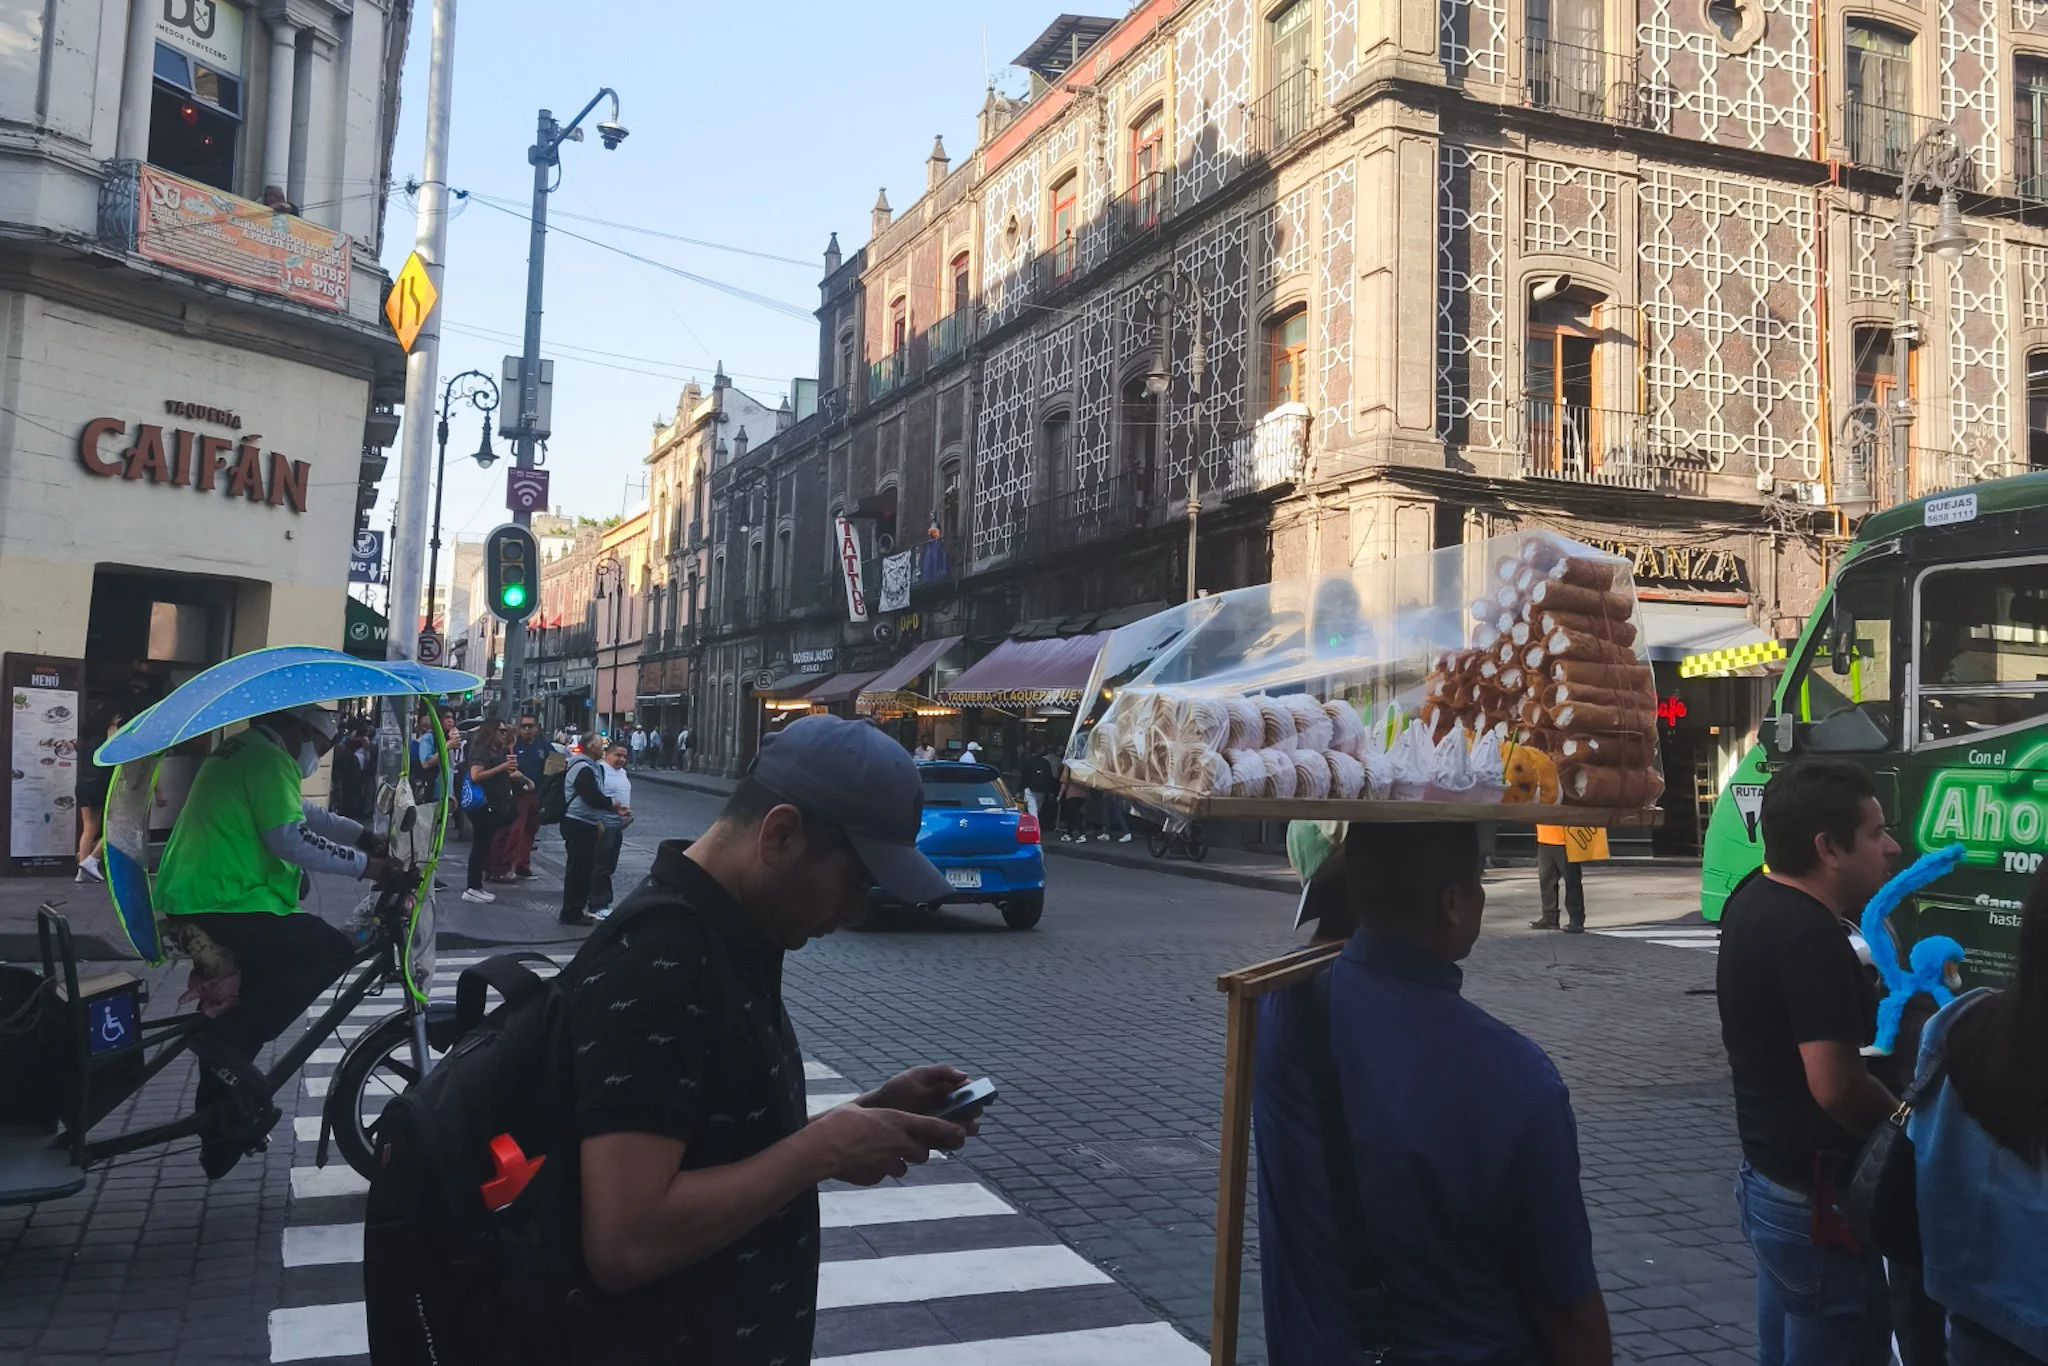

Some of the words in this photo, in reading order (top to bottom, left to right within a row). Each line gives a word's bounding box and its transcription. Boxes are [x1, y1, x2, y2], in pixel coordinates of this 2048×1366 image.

[156, 23, 184, 40] MEDOR
[312, 263, 346, 285] SUBE
[286, 270, 311, 289] 1er
[313, 279, 346, 298] PISO
[80, 417, 312, 513] CAIFÁN
[1927, 498, 1973, 513] QUEJAS
[1927, 513, 1949, 524] 5658
[1952, 510, 1974, 519] 1111
[1968, 749, 1992, 765] Con
[1994, 749, 2007, 765] el
[1736, 786, 1765, 797] RUTA
[1932, 784, 2048, 846] Aho
